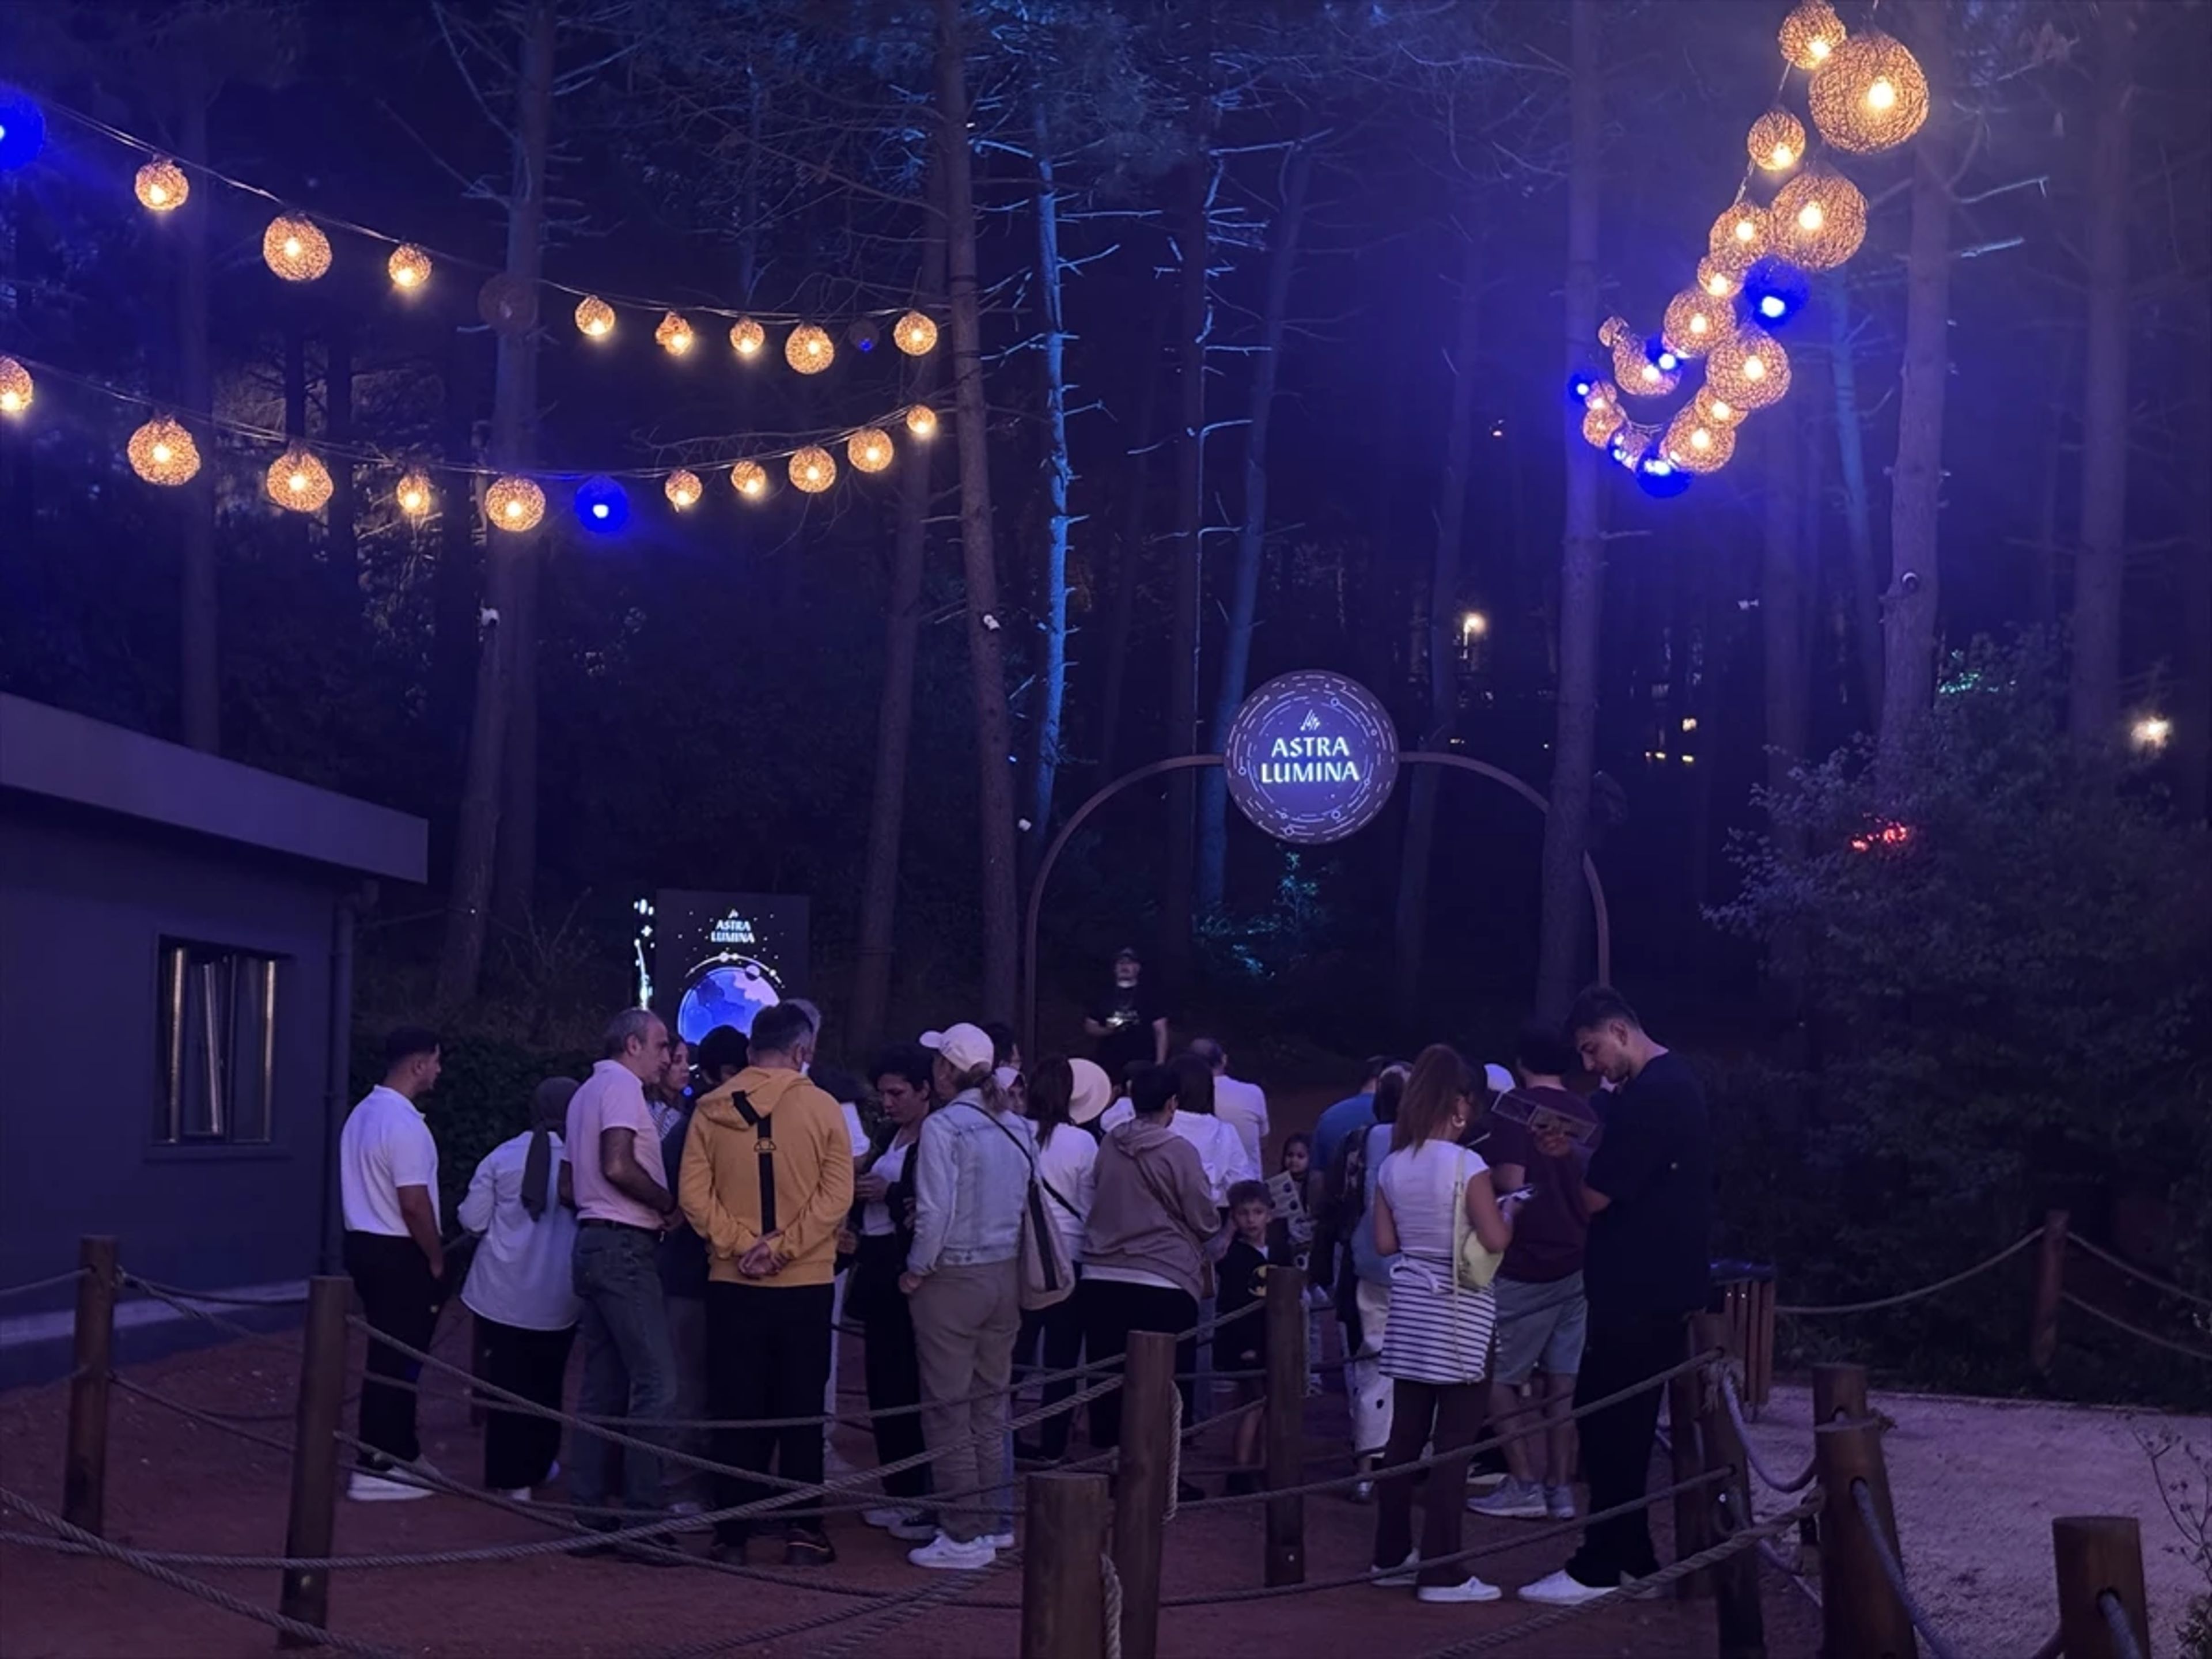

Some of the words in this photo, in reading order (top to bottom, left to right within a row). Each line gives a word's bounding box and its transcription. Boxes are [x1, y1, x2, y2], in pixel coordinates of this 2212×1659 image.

[1271, 737, 1350, 757] ASTRA
[1261, 761, 1360, 783] LUMINA
[716, 920, 751, 931] ASTRA
[711, 931, 755, 942] LUMINA
